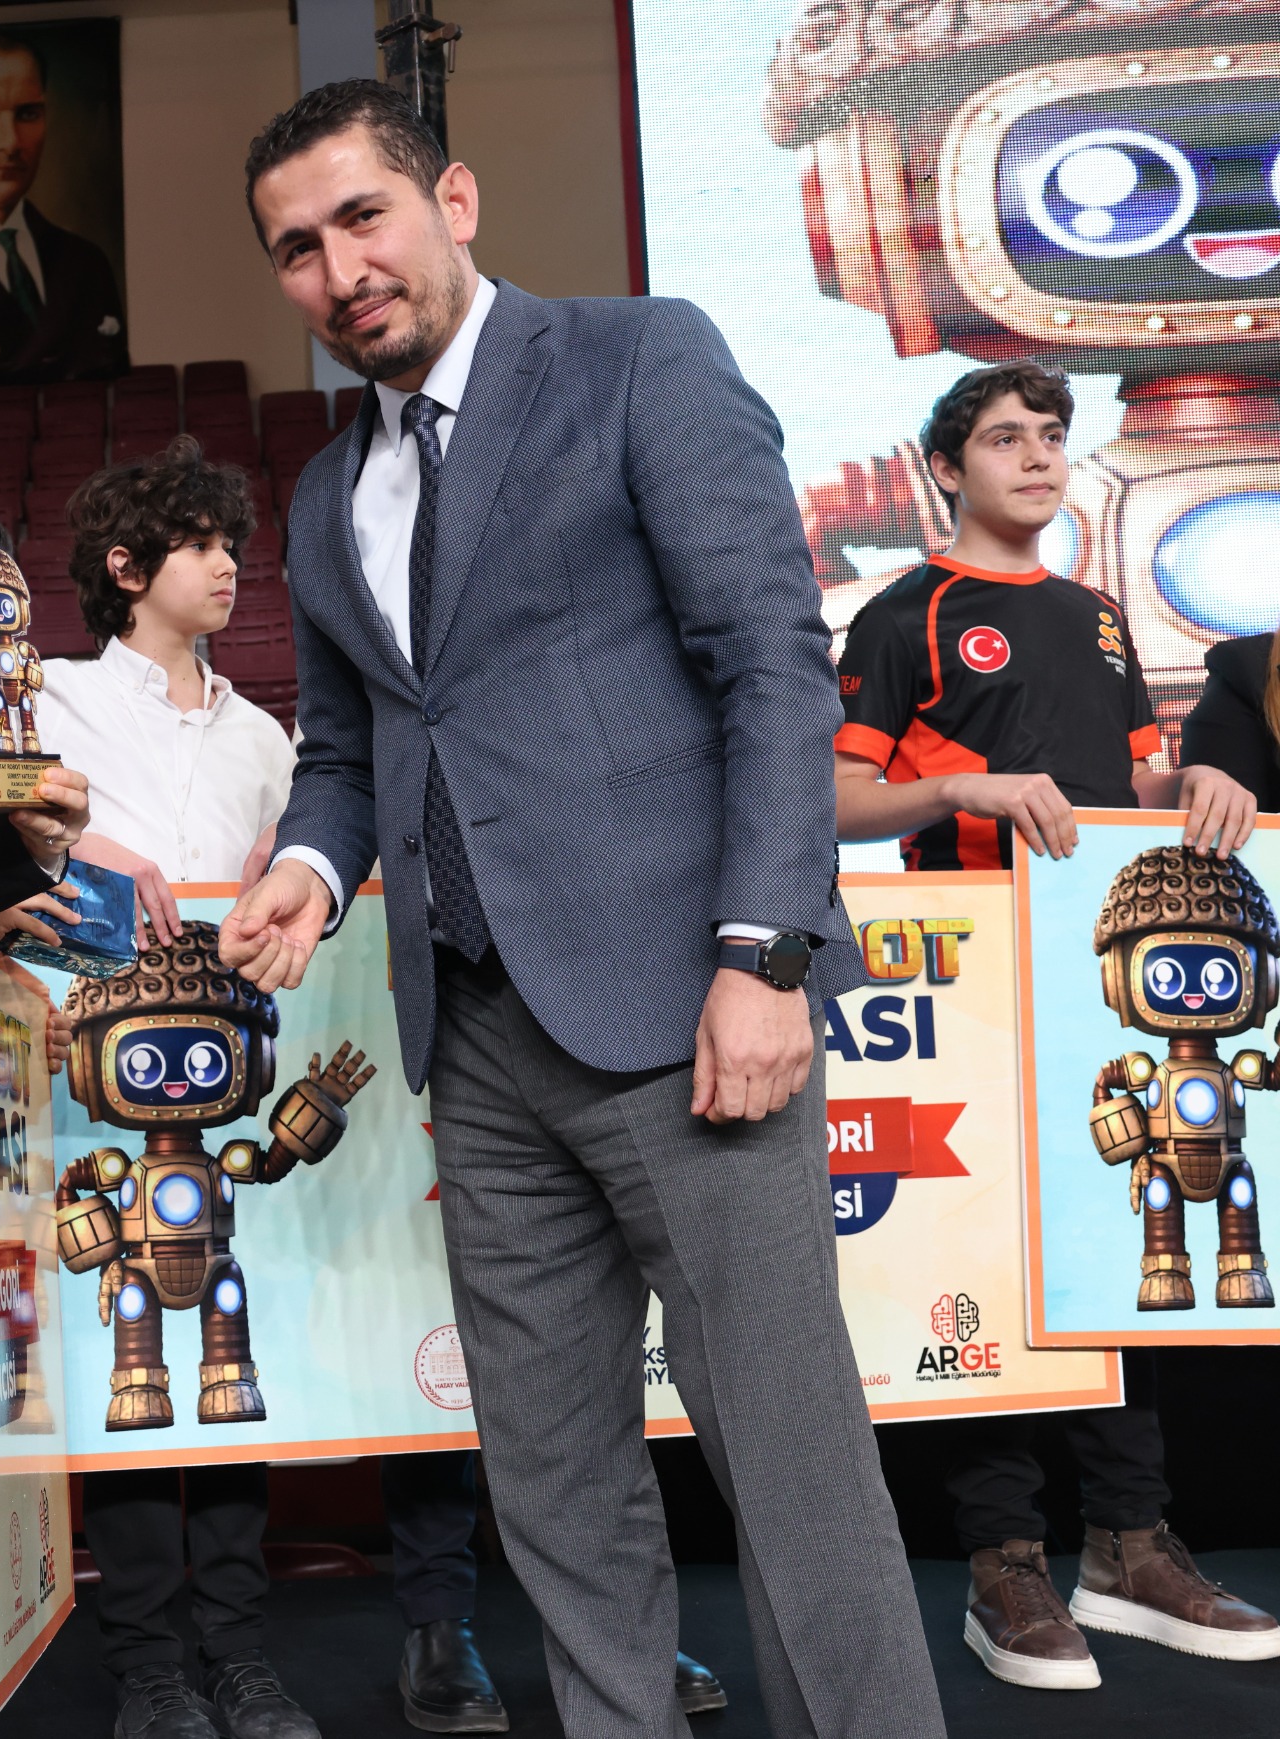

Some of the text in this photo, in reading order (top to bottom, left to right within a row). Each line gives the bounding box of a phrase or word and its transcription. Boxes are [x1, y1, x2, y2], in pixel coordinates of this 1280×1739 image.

[839, 675, 863, 692] TEAM
[851, 917, 975, 983] OT
[916, 1342, 1002, 1374] ARGE
[434, 1381, 454, 1389] HATAY
[916, 1374, 934, 1382] Hatay
[951, 1371, 970, 1381] Eğitim
[971, 1370, 1001, 1379] Müdürlüğü
[39, 1546, 56, 1596] ARGE
